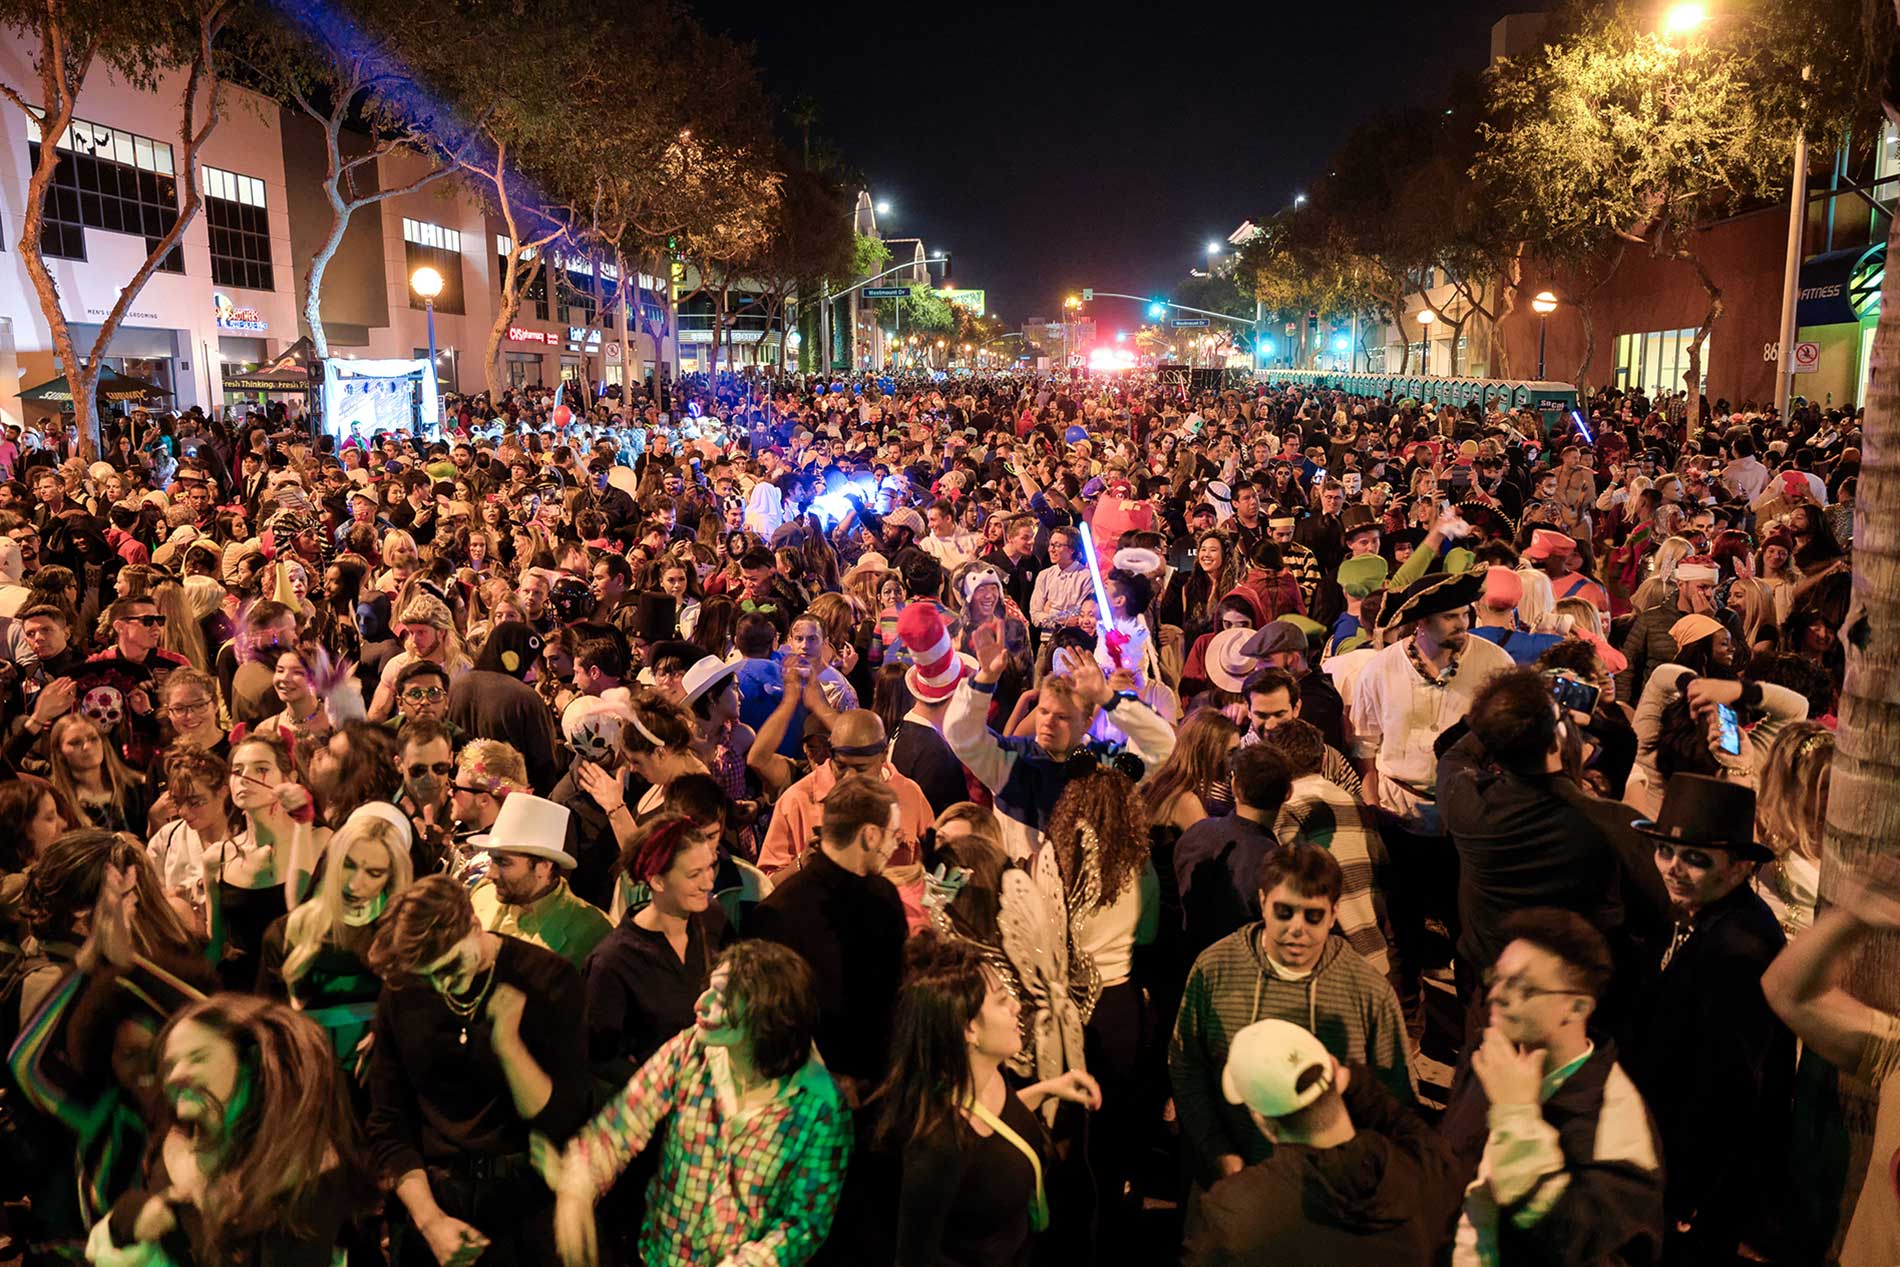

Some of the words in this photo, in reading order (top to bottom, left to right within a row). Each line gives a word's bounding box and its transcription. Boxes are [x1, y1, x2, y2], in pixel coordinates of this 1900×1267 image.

[1800, 284, 1842, 300] FITNESS
[241, 380, 275, 389] Thinking.
[106, 389, 148, 401] SUBWAY
